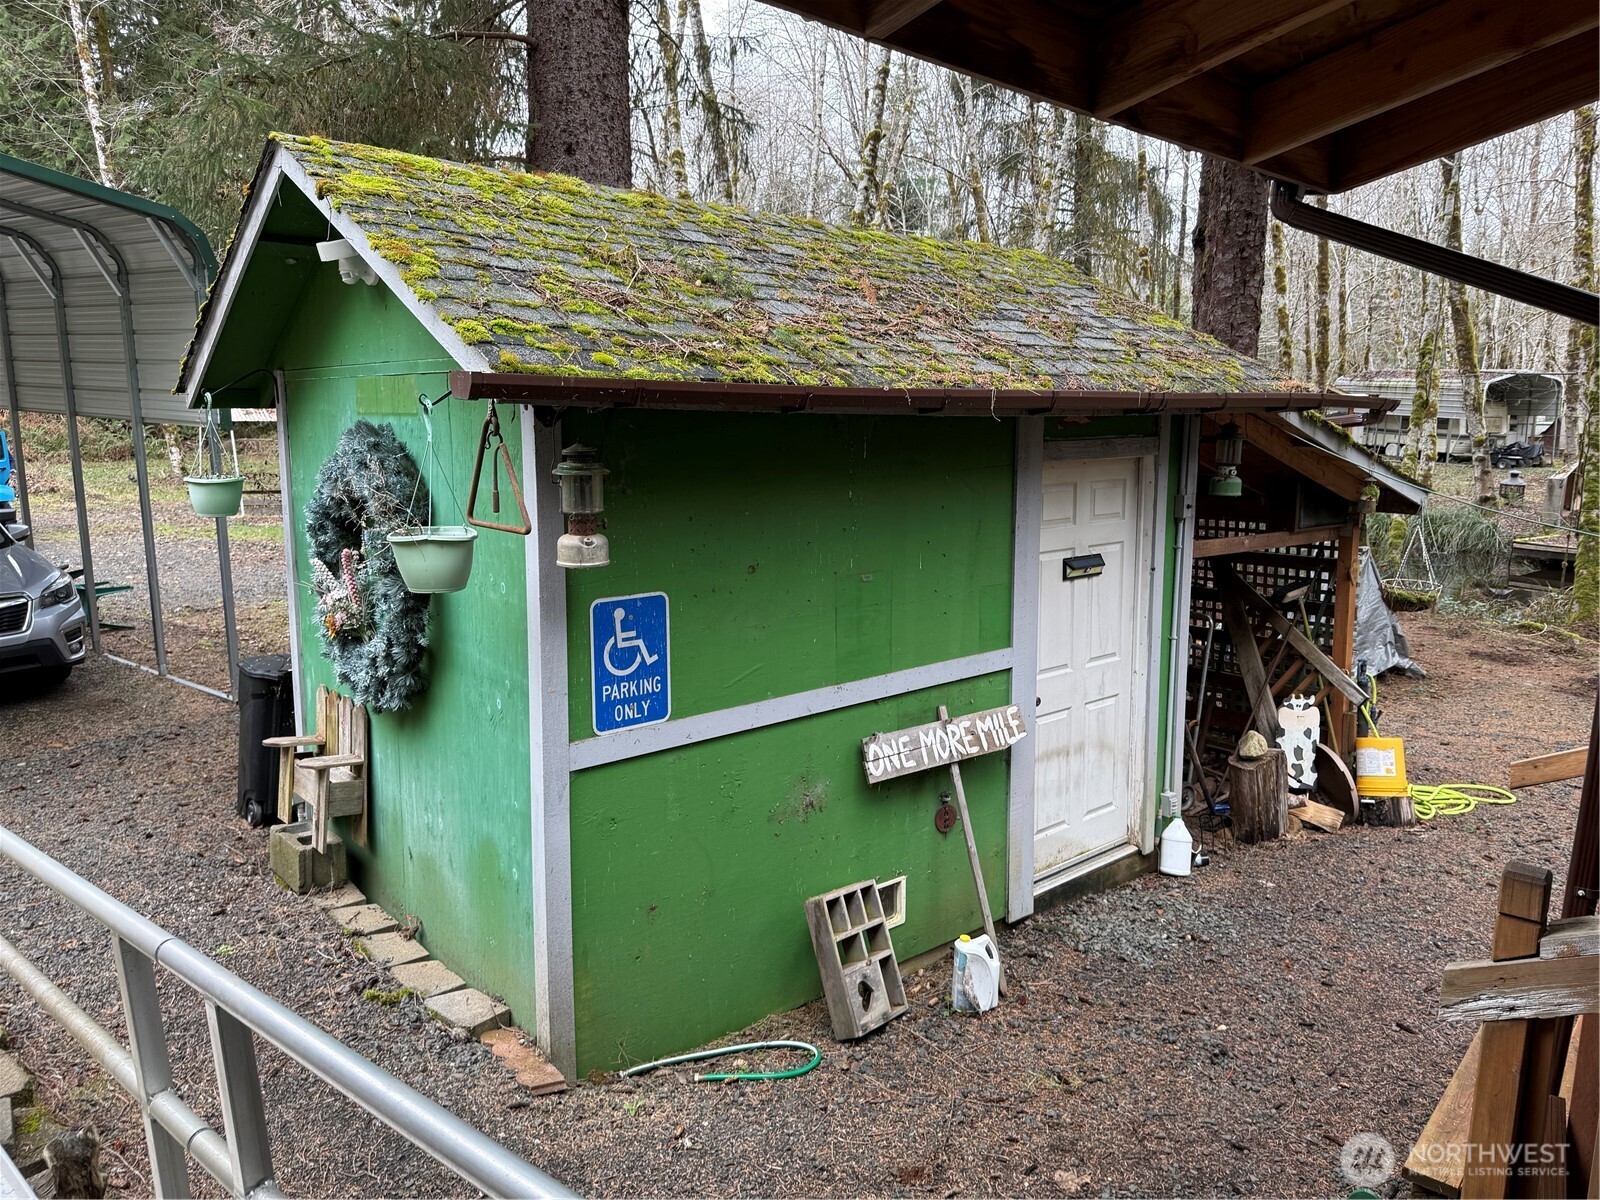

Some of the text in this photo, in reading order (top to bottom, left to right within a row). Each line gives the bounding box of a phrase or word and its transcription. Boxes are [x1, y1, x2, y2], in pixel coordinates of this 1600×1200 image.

[602, 676, 661, 703] PARKING
[614, 700, 650, 722] ONLY
[867, 706, 1028, 777] ONE MORE MILE
